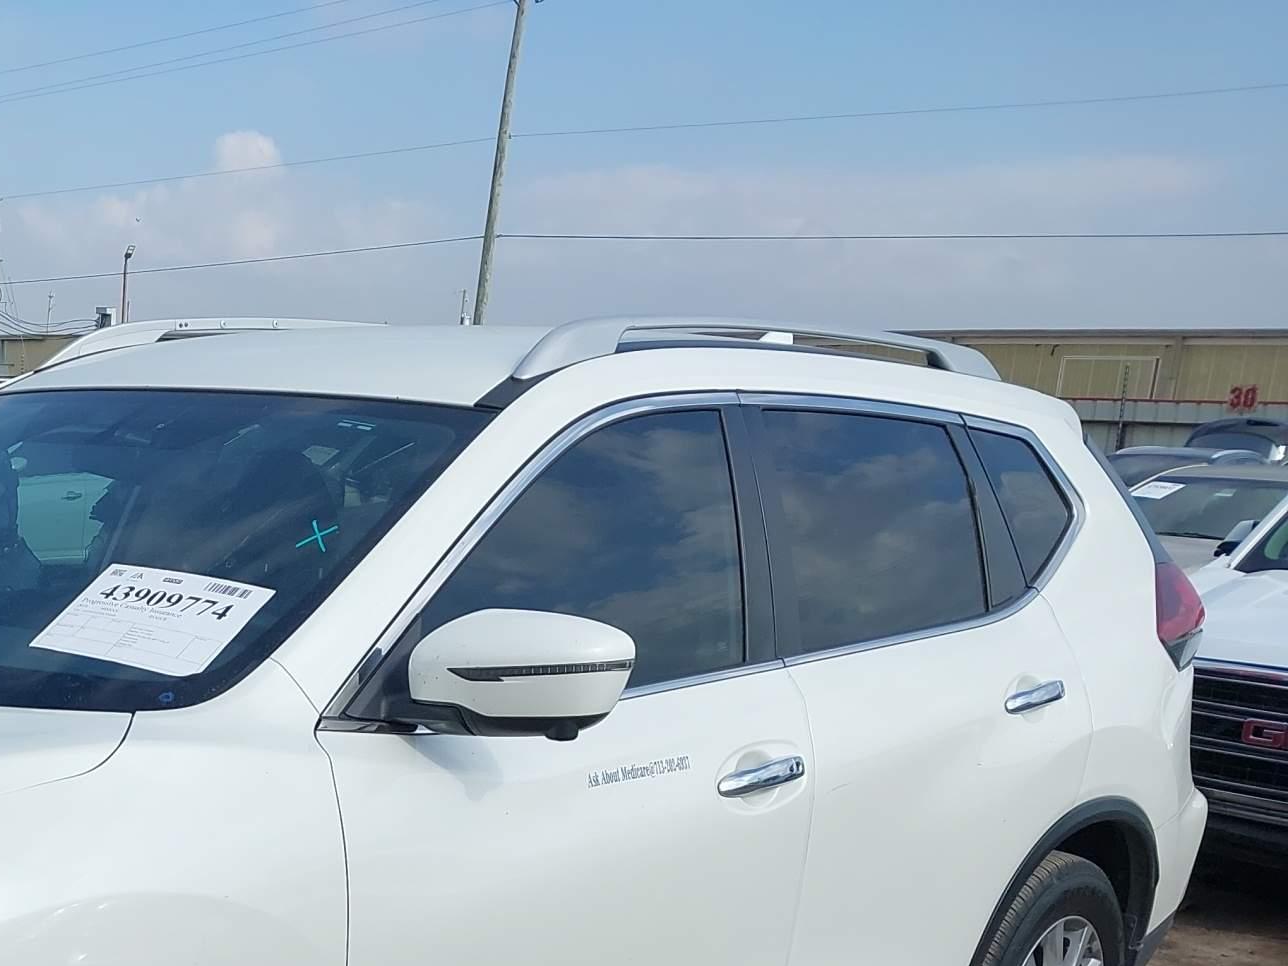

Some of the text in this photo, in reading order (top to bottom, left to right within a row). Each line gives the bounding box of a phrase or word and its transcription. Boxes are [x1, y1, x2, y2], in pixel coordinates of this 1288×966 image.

[1229, 385, 1258, 409] 30
[99, 584, 236, 621] 43909774
[587, 772, 601, 788] Ask
[601, 767, 621, 785] About
